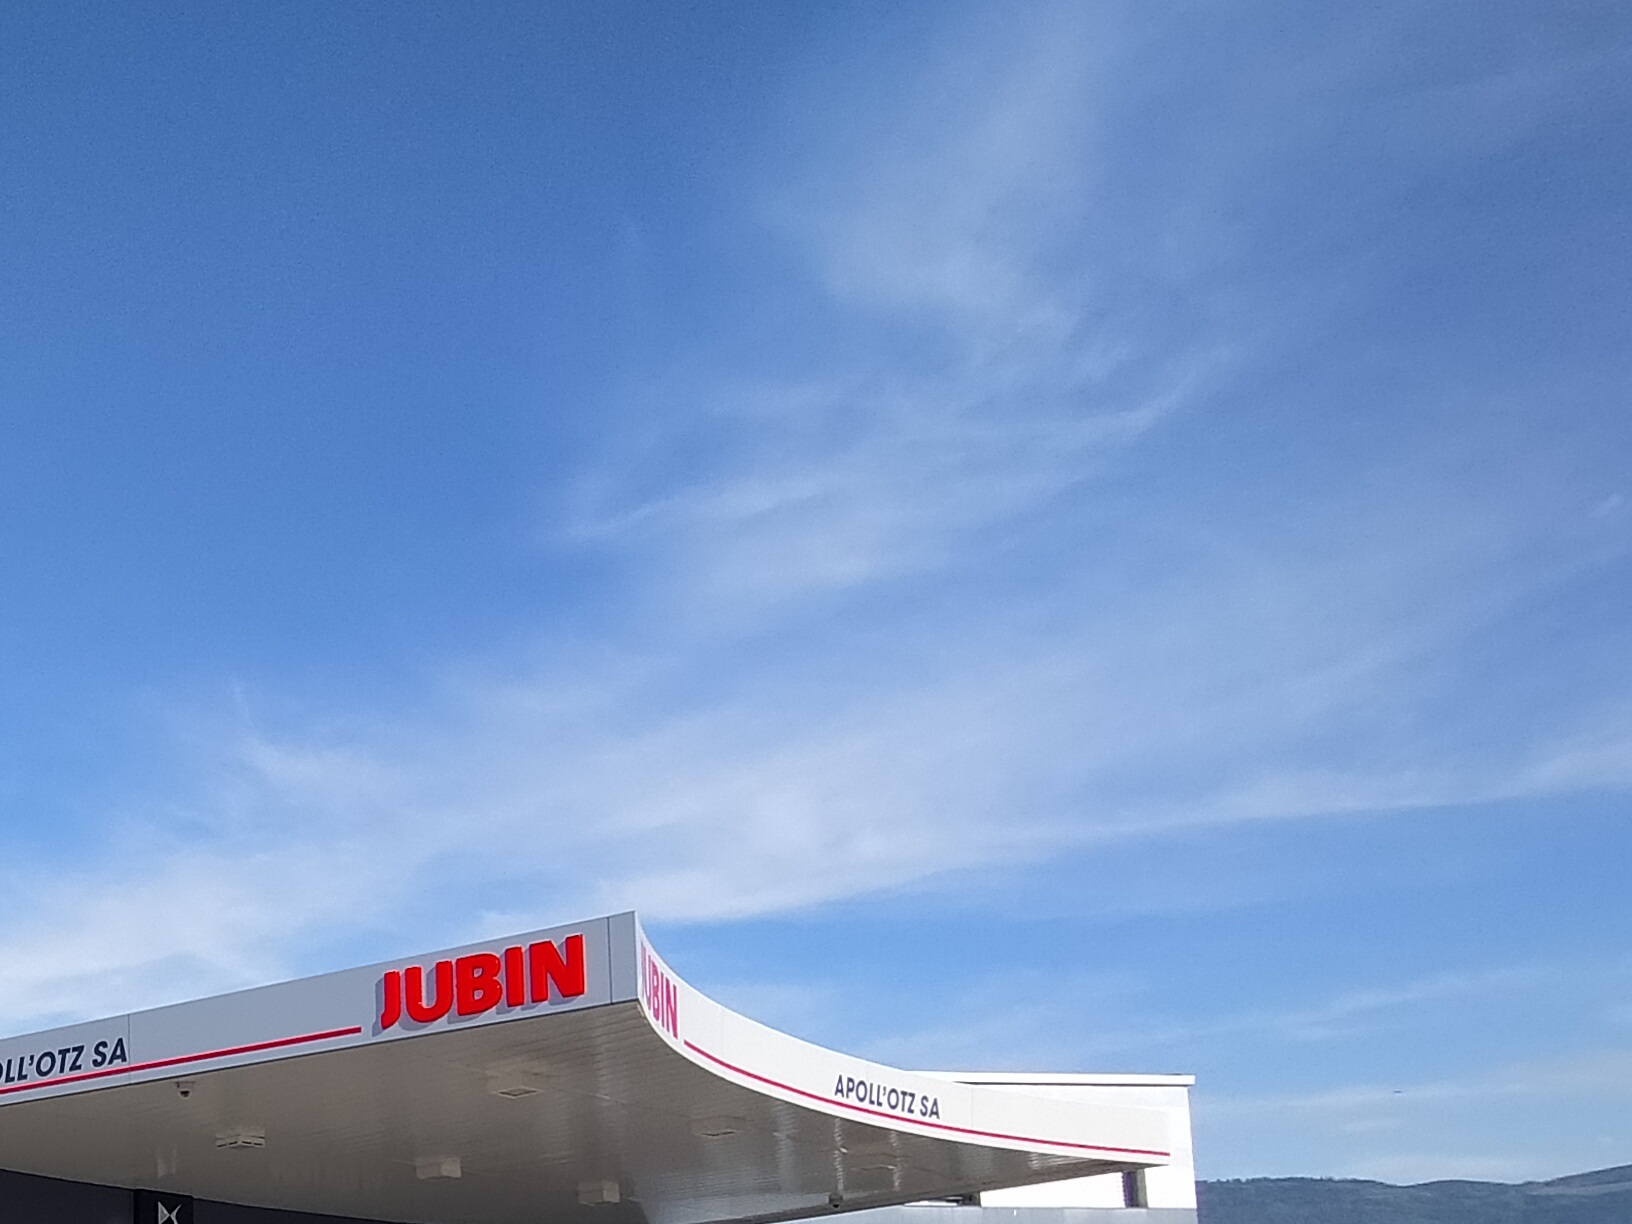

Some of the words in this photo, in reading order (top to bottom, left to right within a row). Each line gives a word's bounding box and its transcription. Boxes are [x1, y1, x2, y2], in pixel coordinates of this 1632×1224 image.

[380, 933, 583, 1030] JUBIN
[91, 1037, 127, 1068] SA
[834, 1074, 916, 1114] APOLL'OTZ
[919, 1095, 940, 1120] SA
